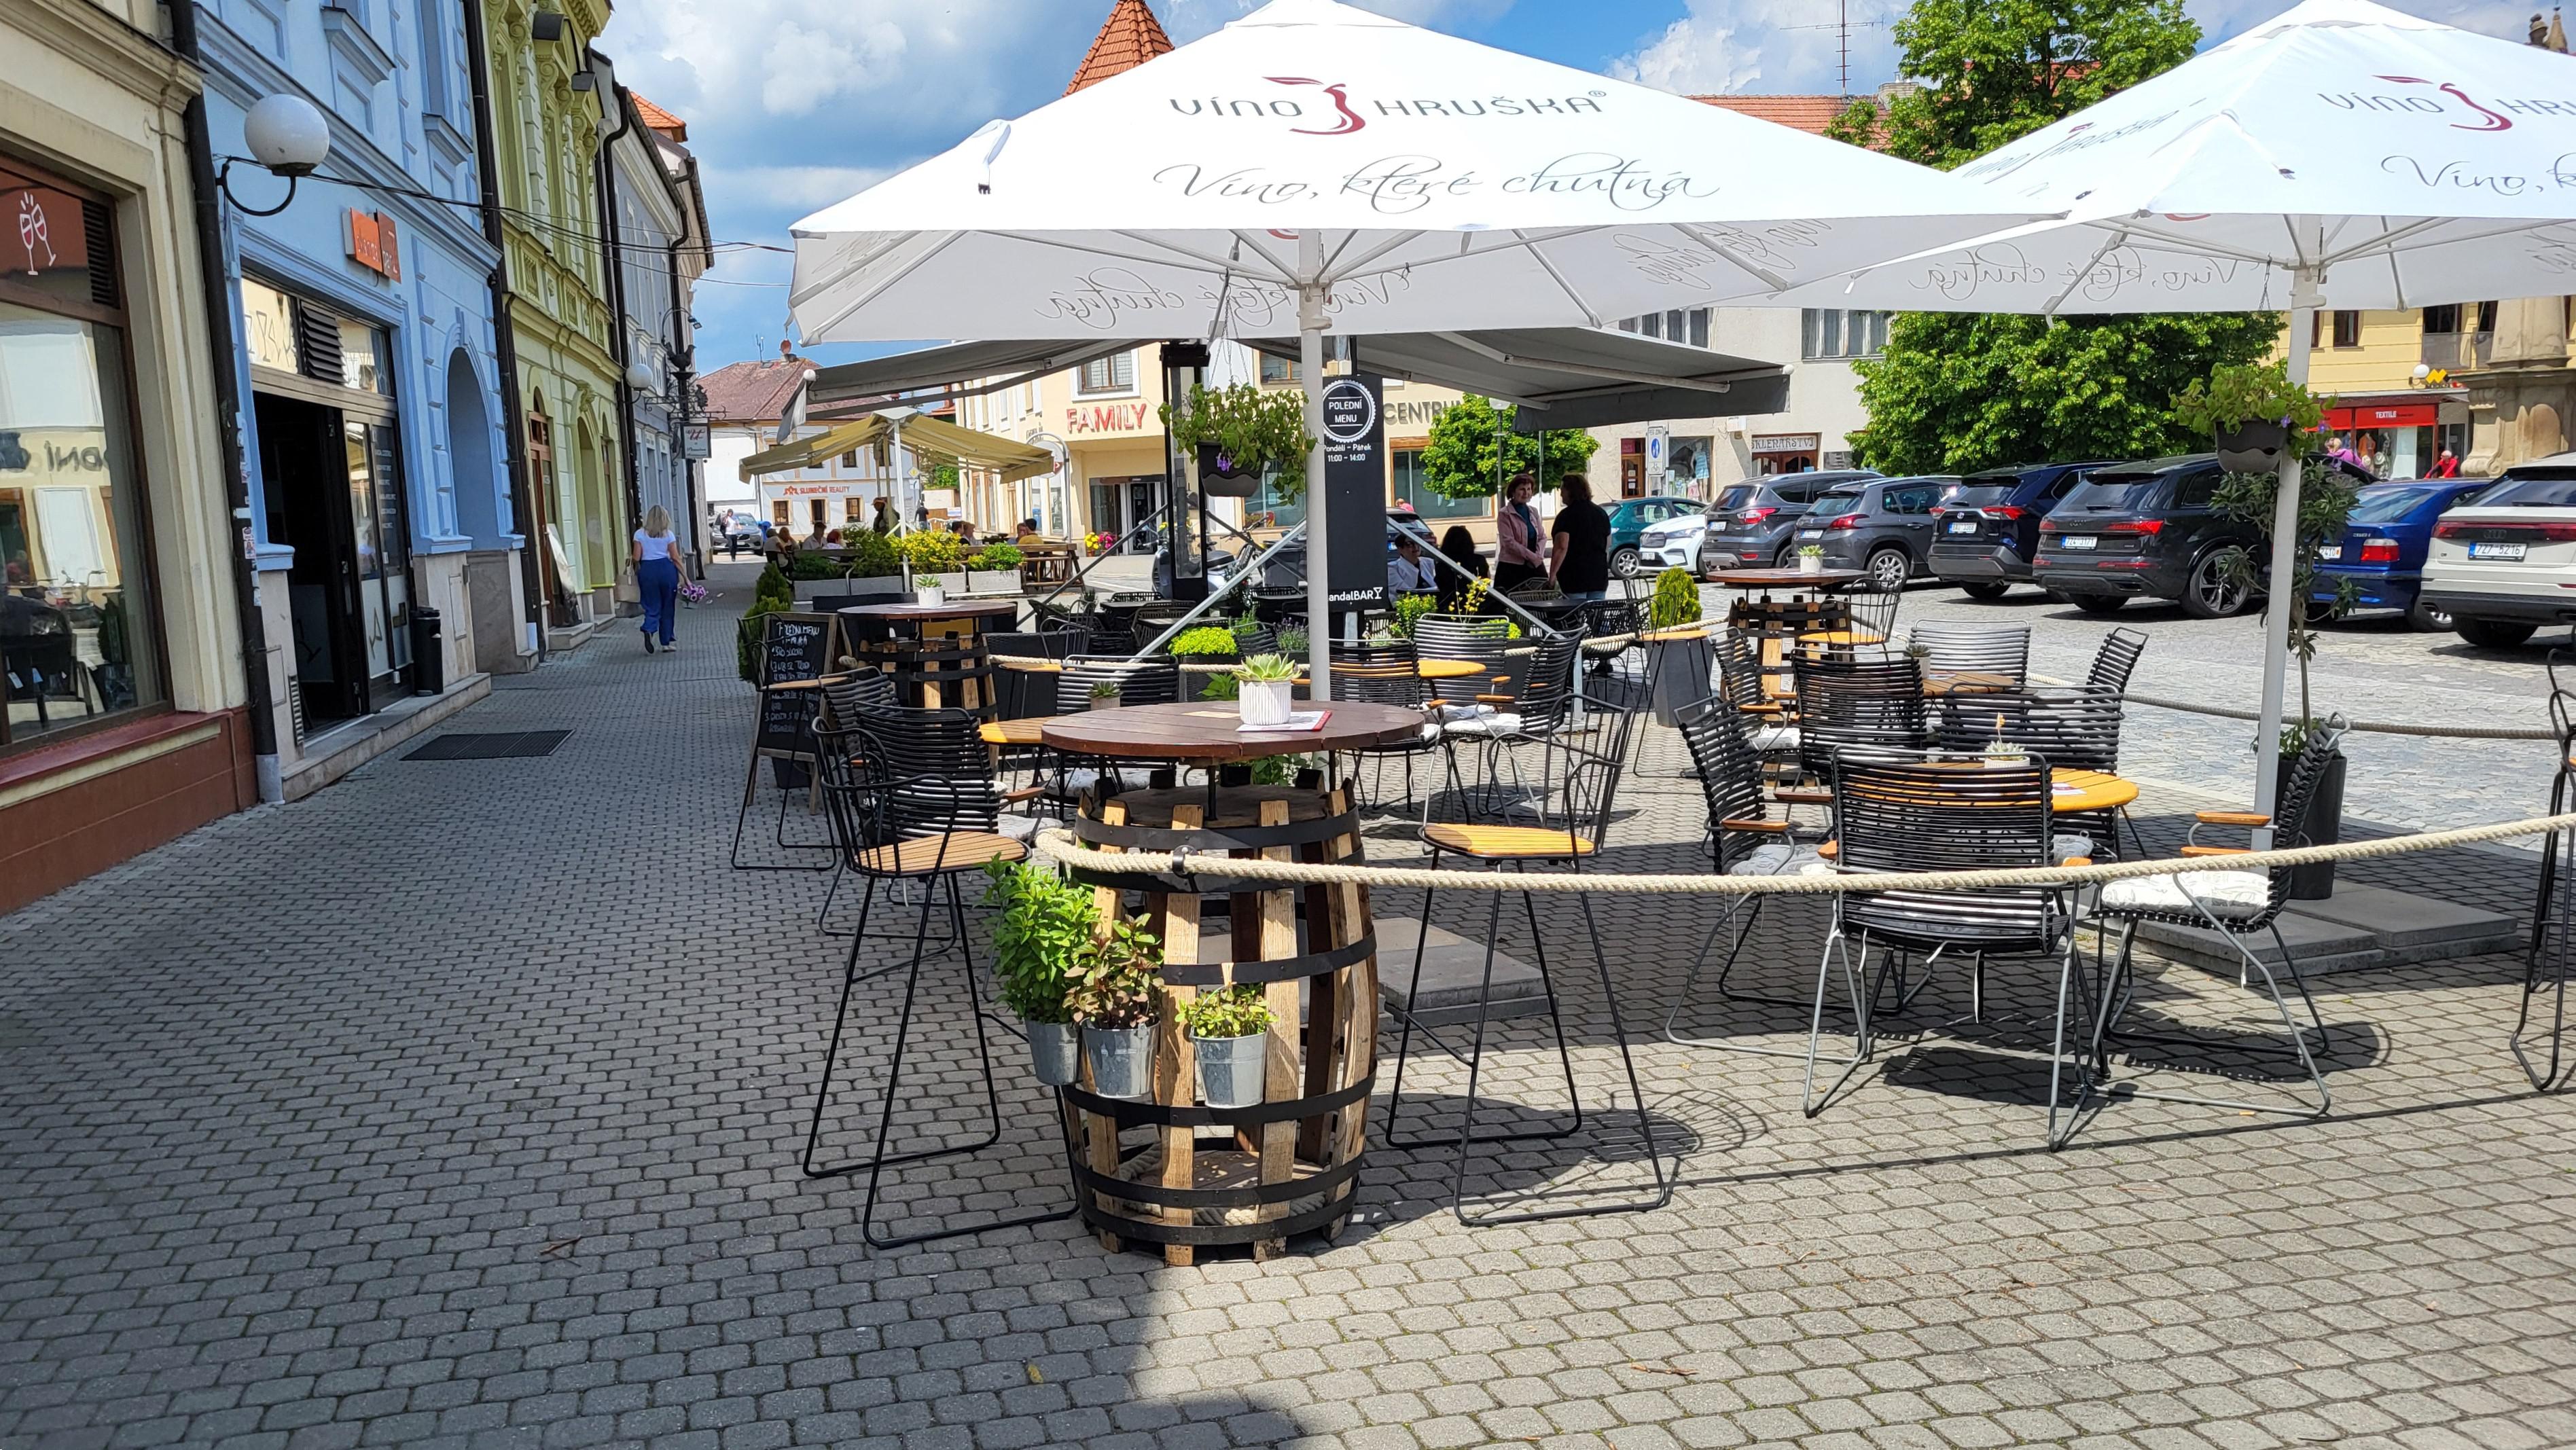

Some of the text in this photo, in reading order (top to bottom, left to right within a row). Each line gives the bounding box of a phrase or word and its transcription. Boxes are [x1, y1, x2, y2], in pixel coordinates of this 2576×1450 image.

[2380, 155, 2544, 196] Víno,
[1153, 151, 1720, 215] Víno, které chutná
[1329, 399, 1362, 410] POLEDNÍ
[1067, 403, 1147, 434] FAMILY
[1383, 400, 1461, 425] CENTR
[1334, 414, 1357, 423] MENU
[2375, 411, 2397, 419] TEXTILE
[1353, 443, 1372, 451] Pátek
[1327, 454, 1342, 463] 11:00
[1349, 453, 1366, 462] 14:00
[829, 486, 851, 494] REALITY
[2499, 544, 2521, 555] 5216
[1328, 590, 1374, 602] andalBAR
